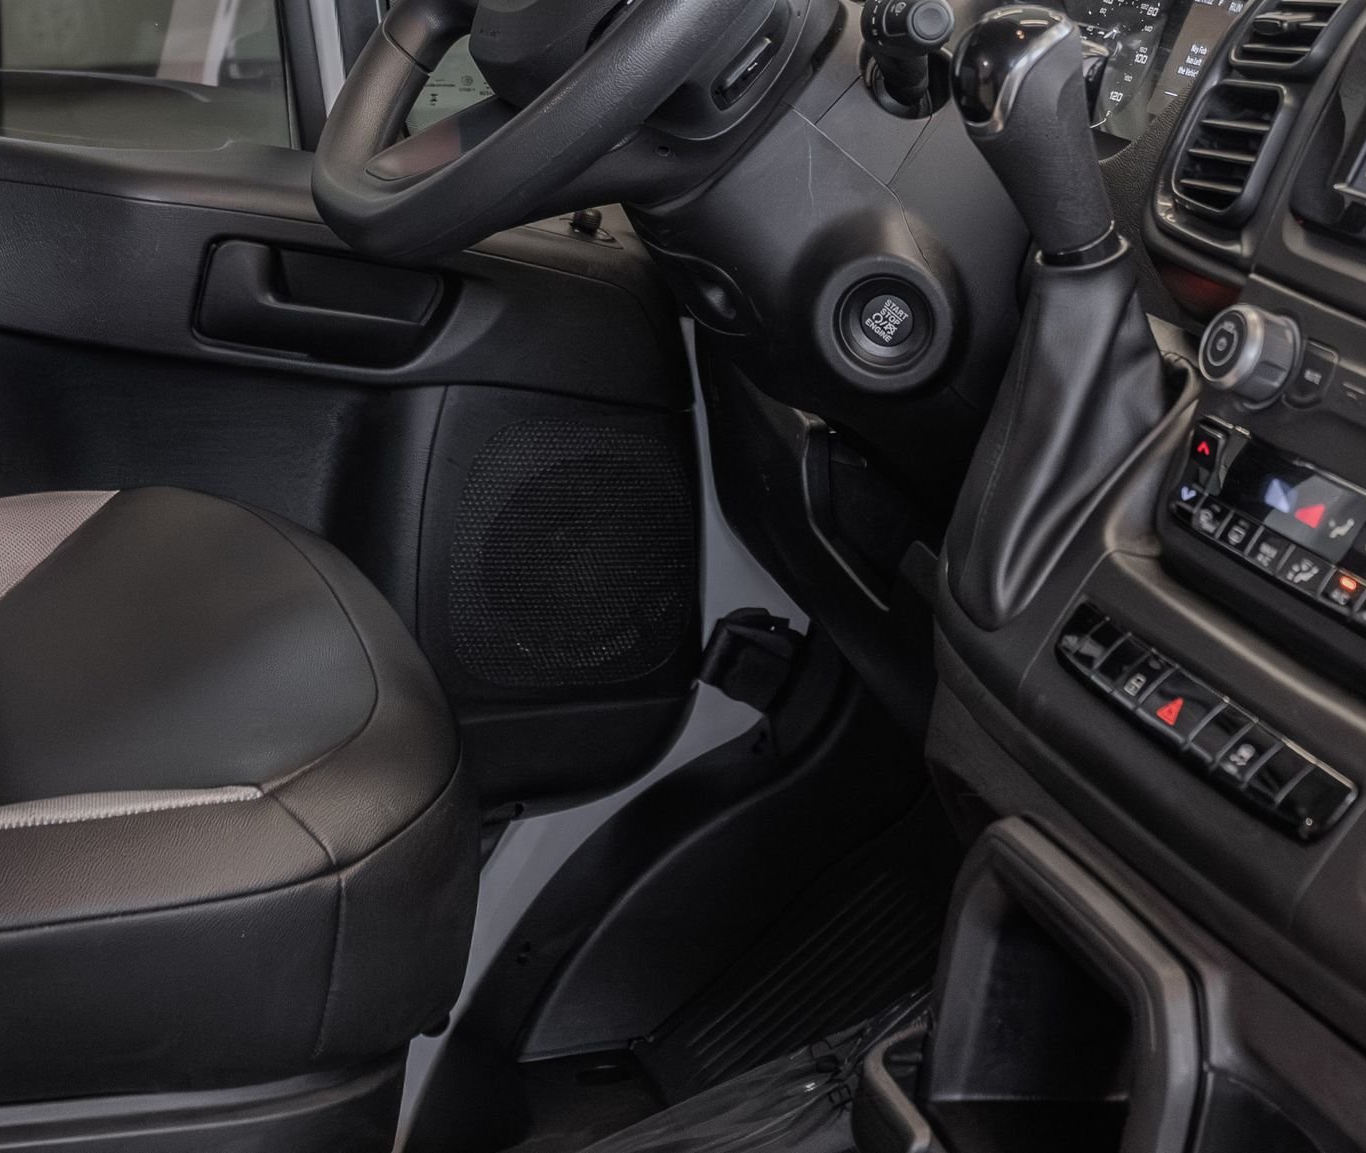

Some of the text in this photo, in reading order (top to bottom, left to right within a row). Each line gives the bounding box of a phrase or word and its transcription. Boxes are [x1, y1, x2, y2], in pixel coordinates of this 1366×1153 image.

[1134, 53, 1148, 64] 100
[1109, 91, 1123, 102] 120
[880, 308, 901, 325] STOP
[885, 299, 909, 320] START
[865, 317, 893, 343] ENGINE
